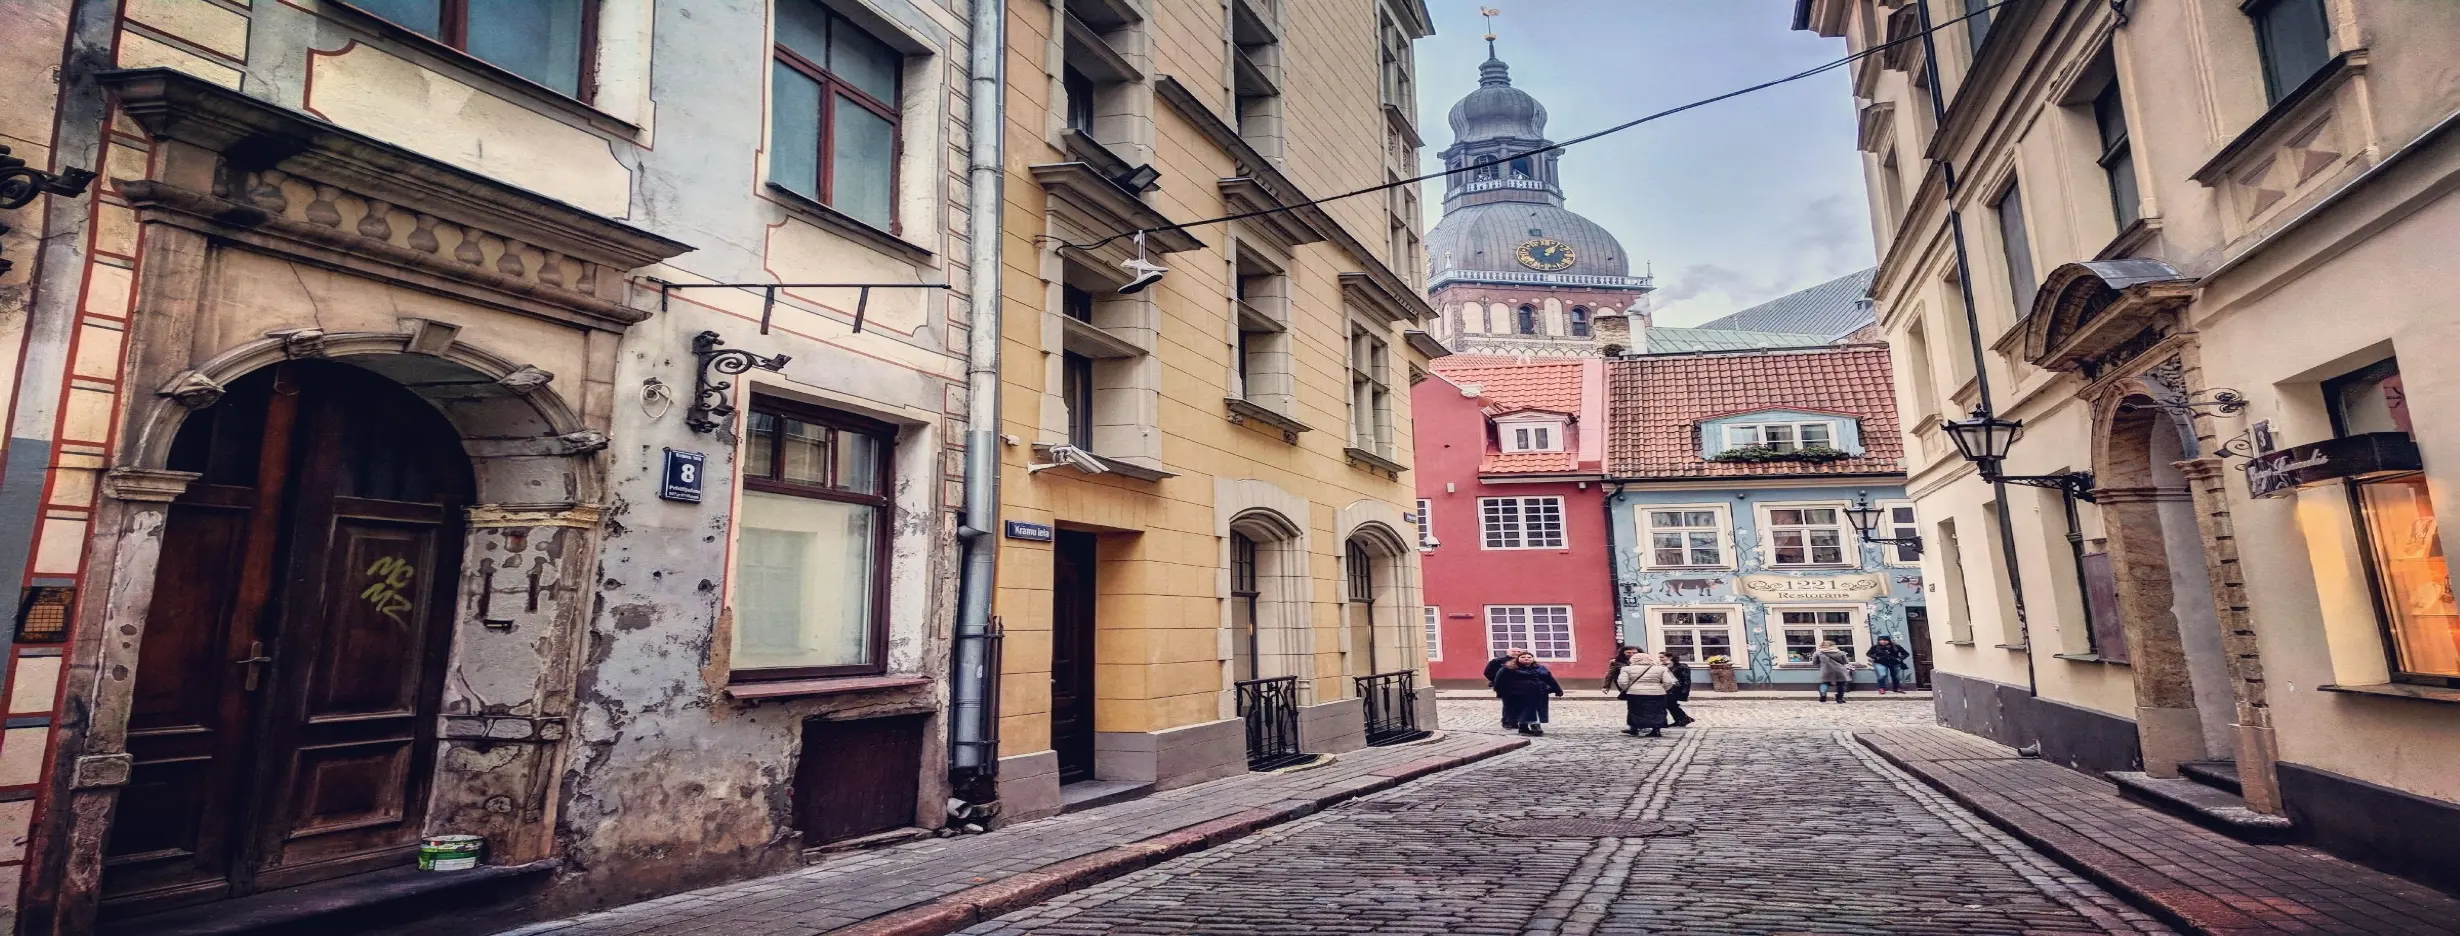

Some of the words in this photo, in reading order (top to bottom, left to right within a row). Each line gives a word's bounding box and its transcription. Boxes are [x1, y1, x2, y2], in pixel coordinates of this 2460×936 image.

[681, 463, 695, 483] 8
[1014, 525, 1037, 536] Krāmu
[1037, 527, 1050, 538] iela
[1786, 579, 1838, 590] 1221
